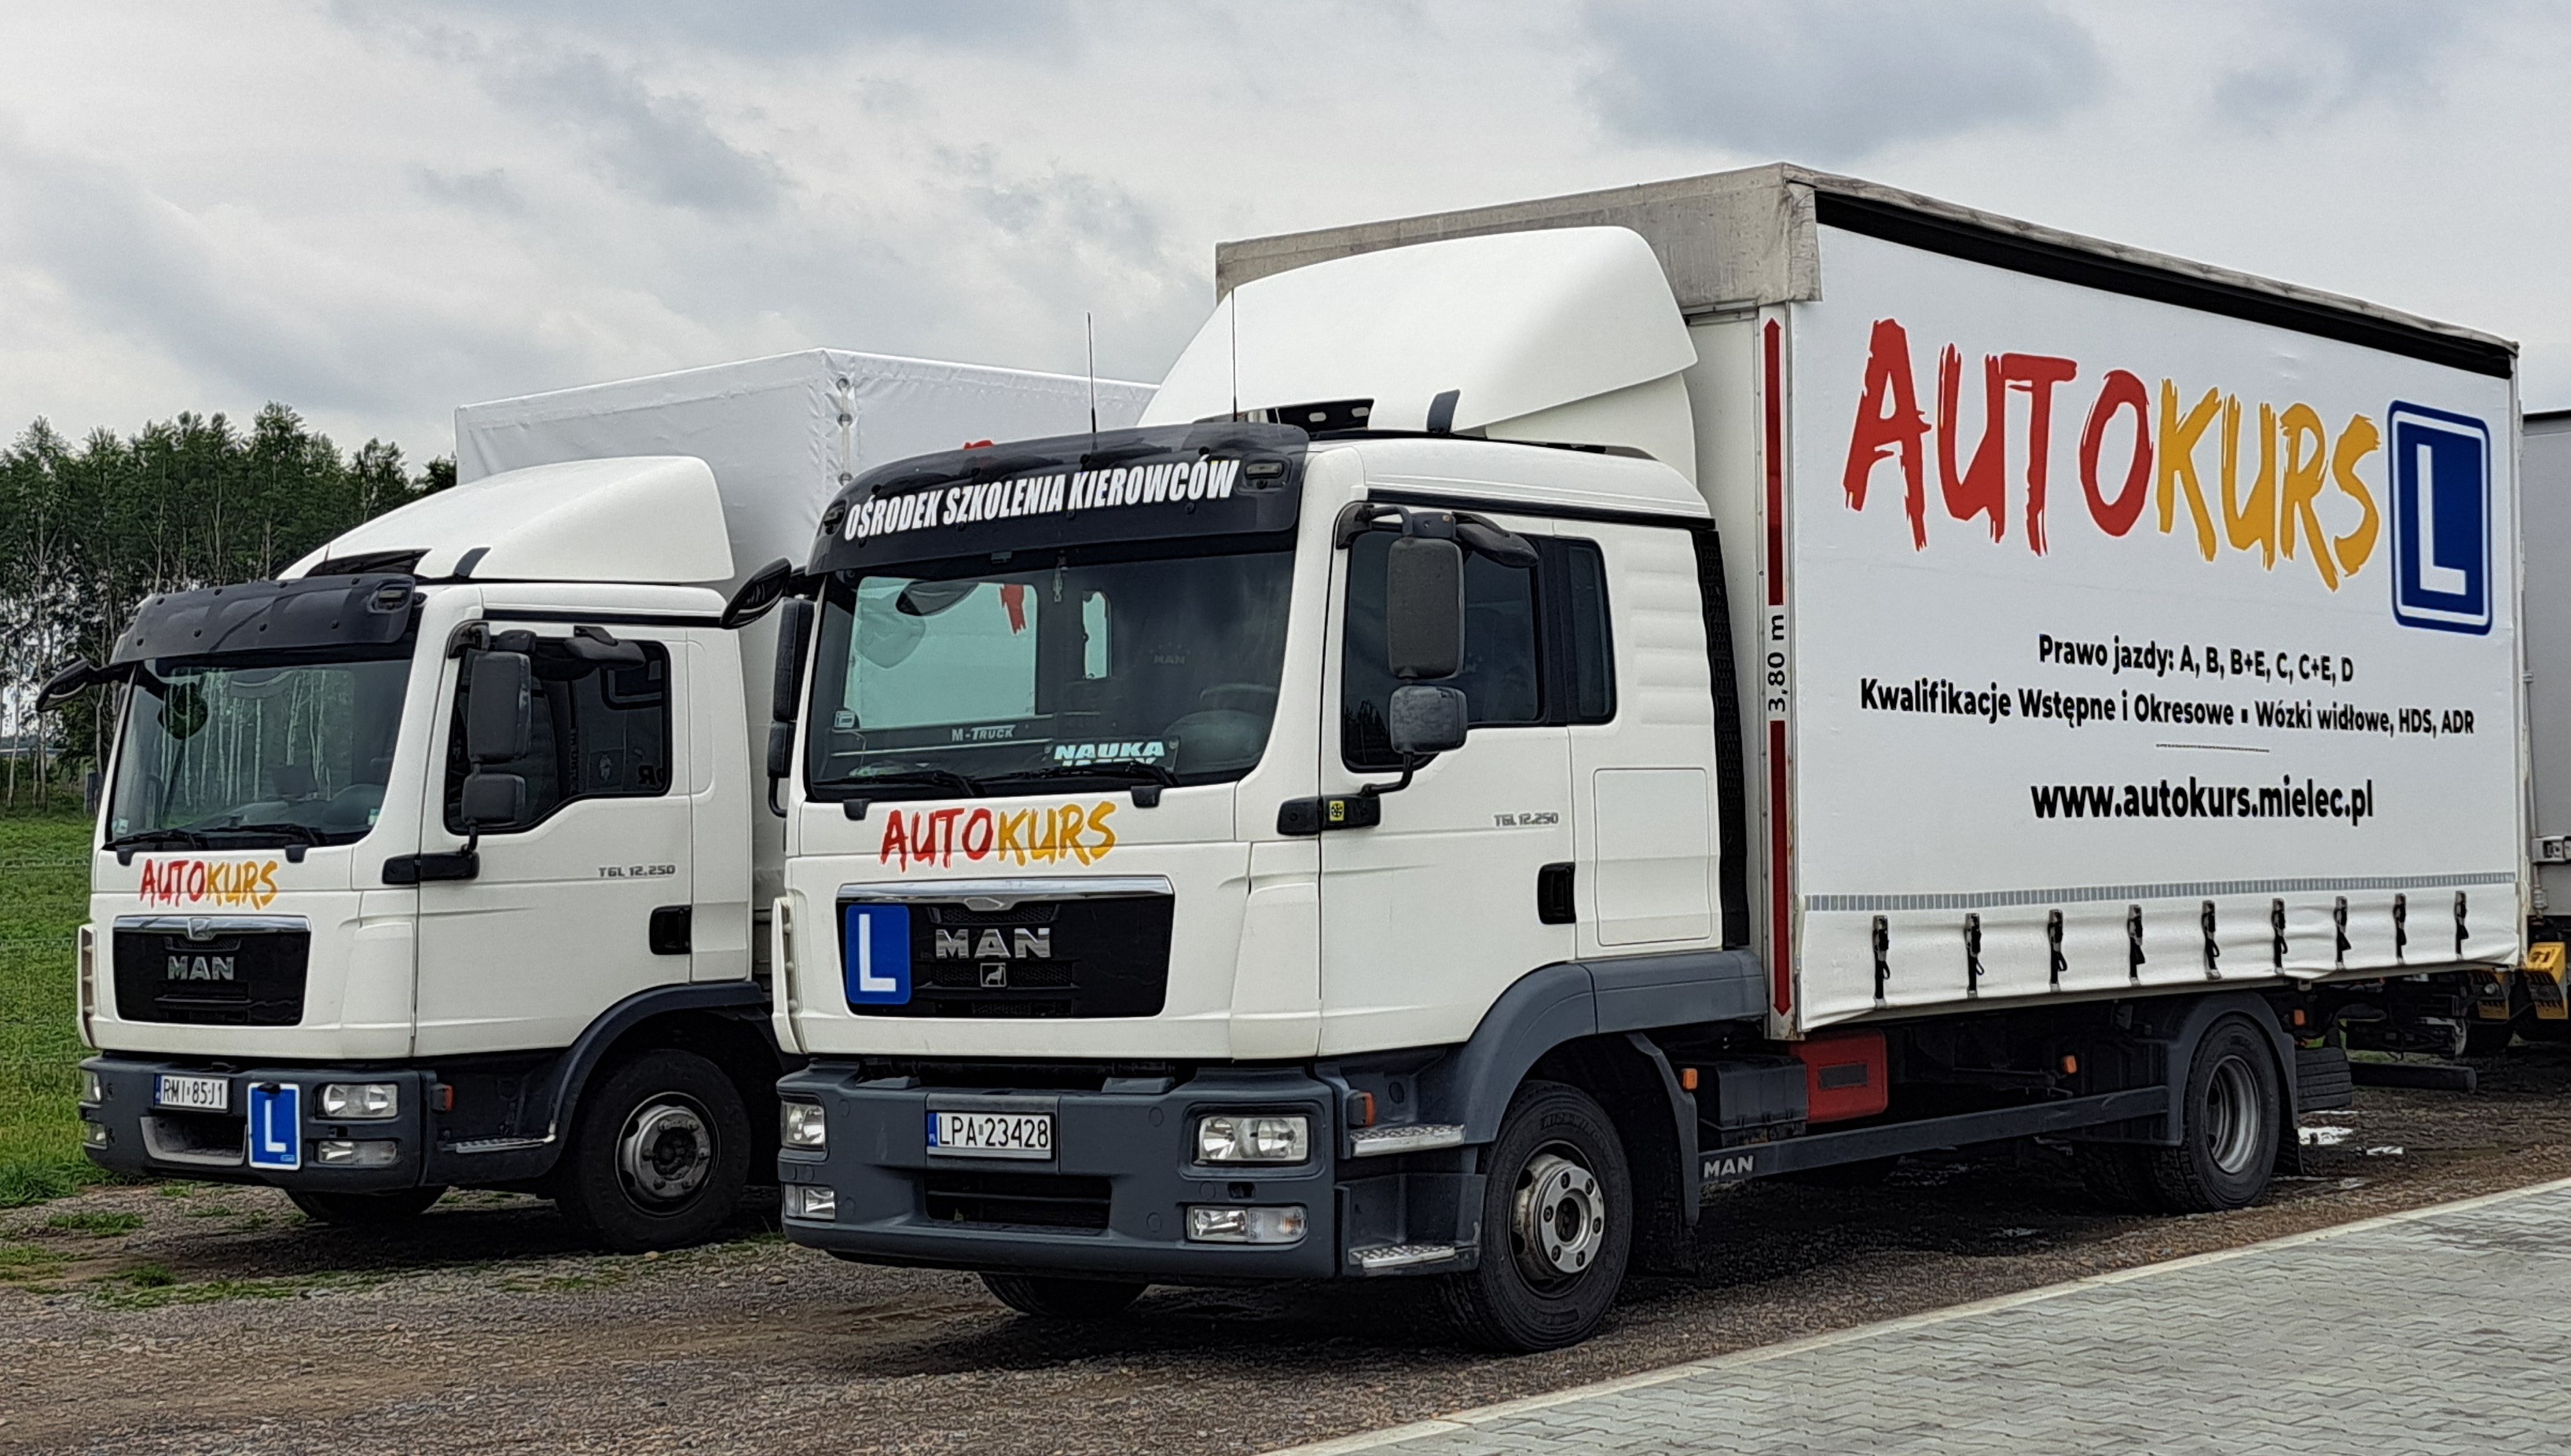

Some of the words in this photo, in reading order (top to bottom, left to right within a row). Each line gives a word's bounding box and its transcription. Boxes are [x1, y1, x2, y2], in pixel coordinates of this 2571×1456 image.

[1843, 317, 2381, 593] AUTOKURS
[844, 489, 944, 541] OŚRODEK
[943, 474, 1066, 526] SZKOLENIA
[1067, 453, 1240, 511] KIEROWCÓW
[2416, 443, 2466, 596] L
[1771, 614, 1784, 640] m
[2039, 634, 2107, 666] Prawo
[2112, 635, 2174, 677] jazdy:
[2180, 644, 2201, 679] A,
[2206, 647, 2225, 681] B,
[2230, 648, 2272, 682] B+E,
[2276, 651, 2294, 684] C,
[2298, 654, 2337, 687] C+E,
[2341, 657, 2355, 682] D
[1860, 677, 2012, 724] Kwalifikacje
[2018, 687, 2117, 728] Wstępne
[2122, 689, 2129, 721] i
[2133, 693, 2234, 725] Okresowe
[2254, 699, 2312, 729] Wózki
[2316, 703, 2395, 738] widłowe,
[2398, 708, 2437, 739] HDS,
[2441, 710, 2475, 735] ADR
[1054, 741, 1166, 760] NAUKA
[2030, 775, 2374, 827] www.autokurs.mielec.pl
[879, 801, 1118, 874] AUTOKURS
[139, 858, 278, 910] AUTOKURS
[629, 864, 676, 877] 12.250
[167, 955, 235, 981] MAN
[859, 914, 897, 992] L
[935, 927, 1051, 959] MAN
[265, 1100, 287, 1153] L
[1704, 1155, 1754, 1179] MAN
